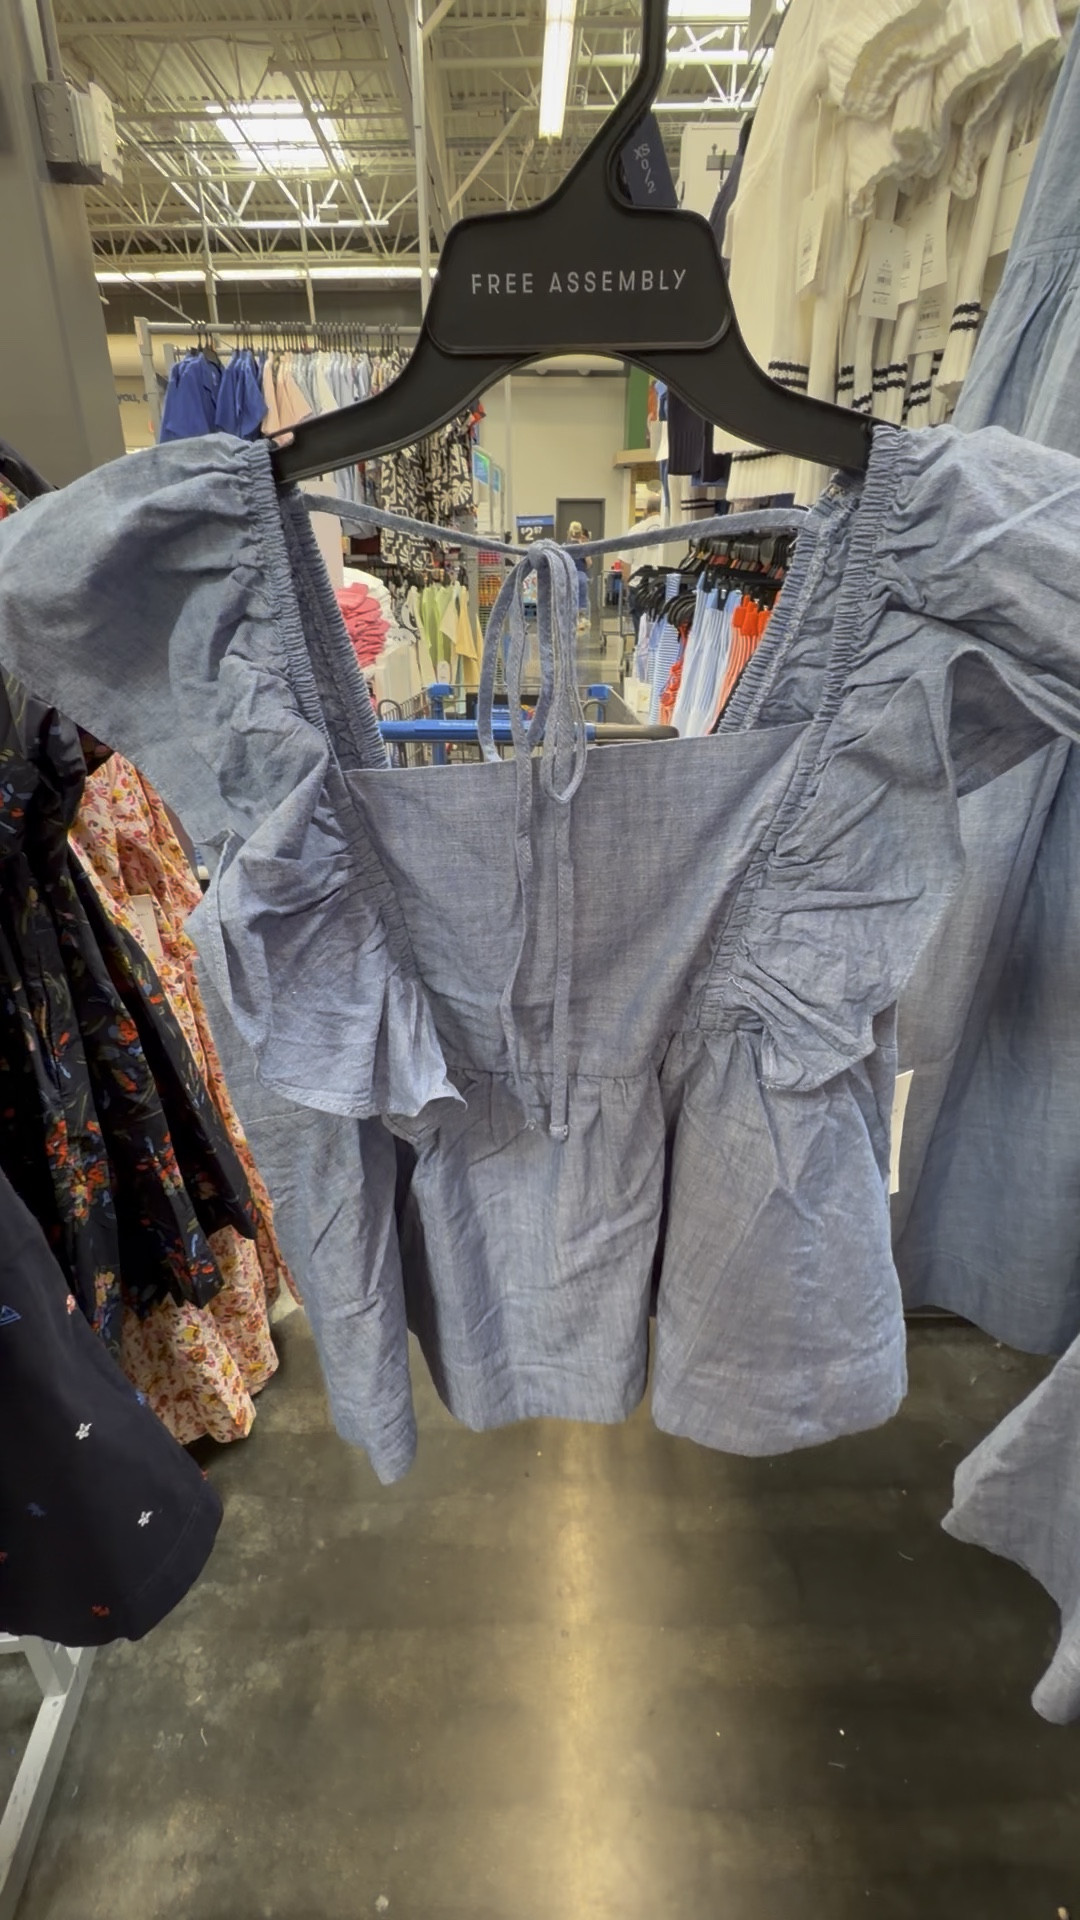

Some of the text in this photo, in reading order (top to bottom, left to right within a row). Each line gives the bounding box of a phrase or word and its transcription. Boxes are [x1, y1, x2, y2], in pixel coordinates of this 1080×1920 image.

[633, 143, 651, 160] XS
[471, 268, 687, 295] FREE ASSEMBLY
